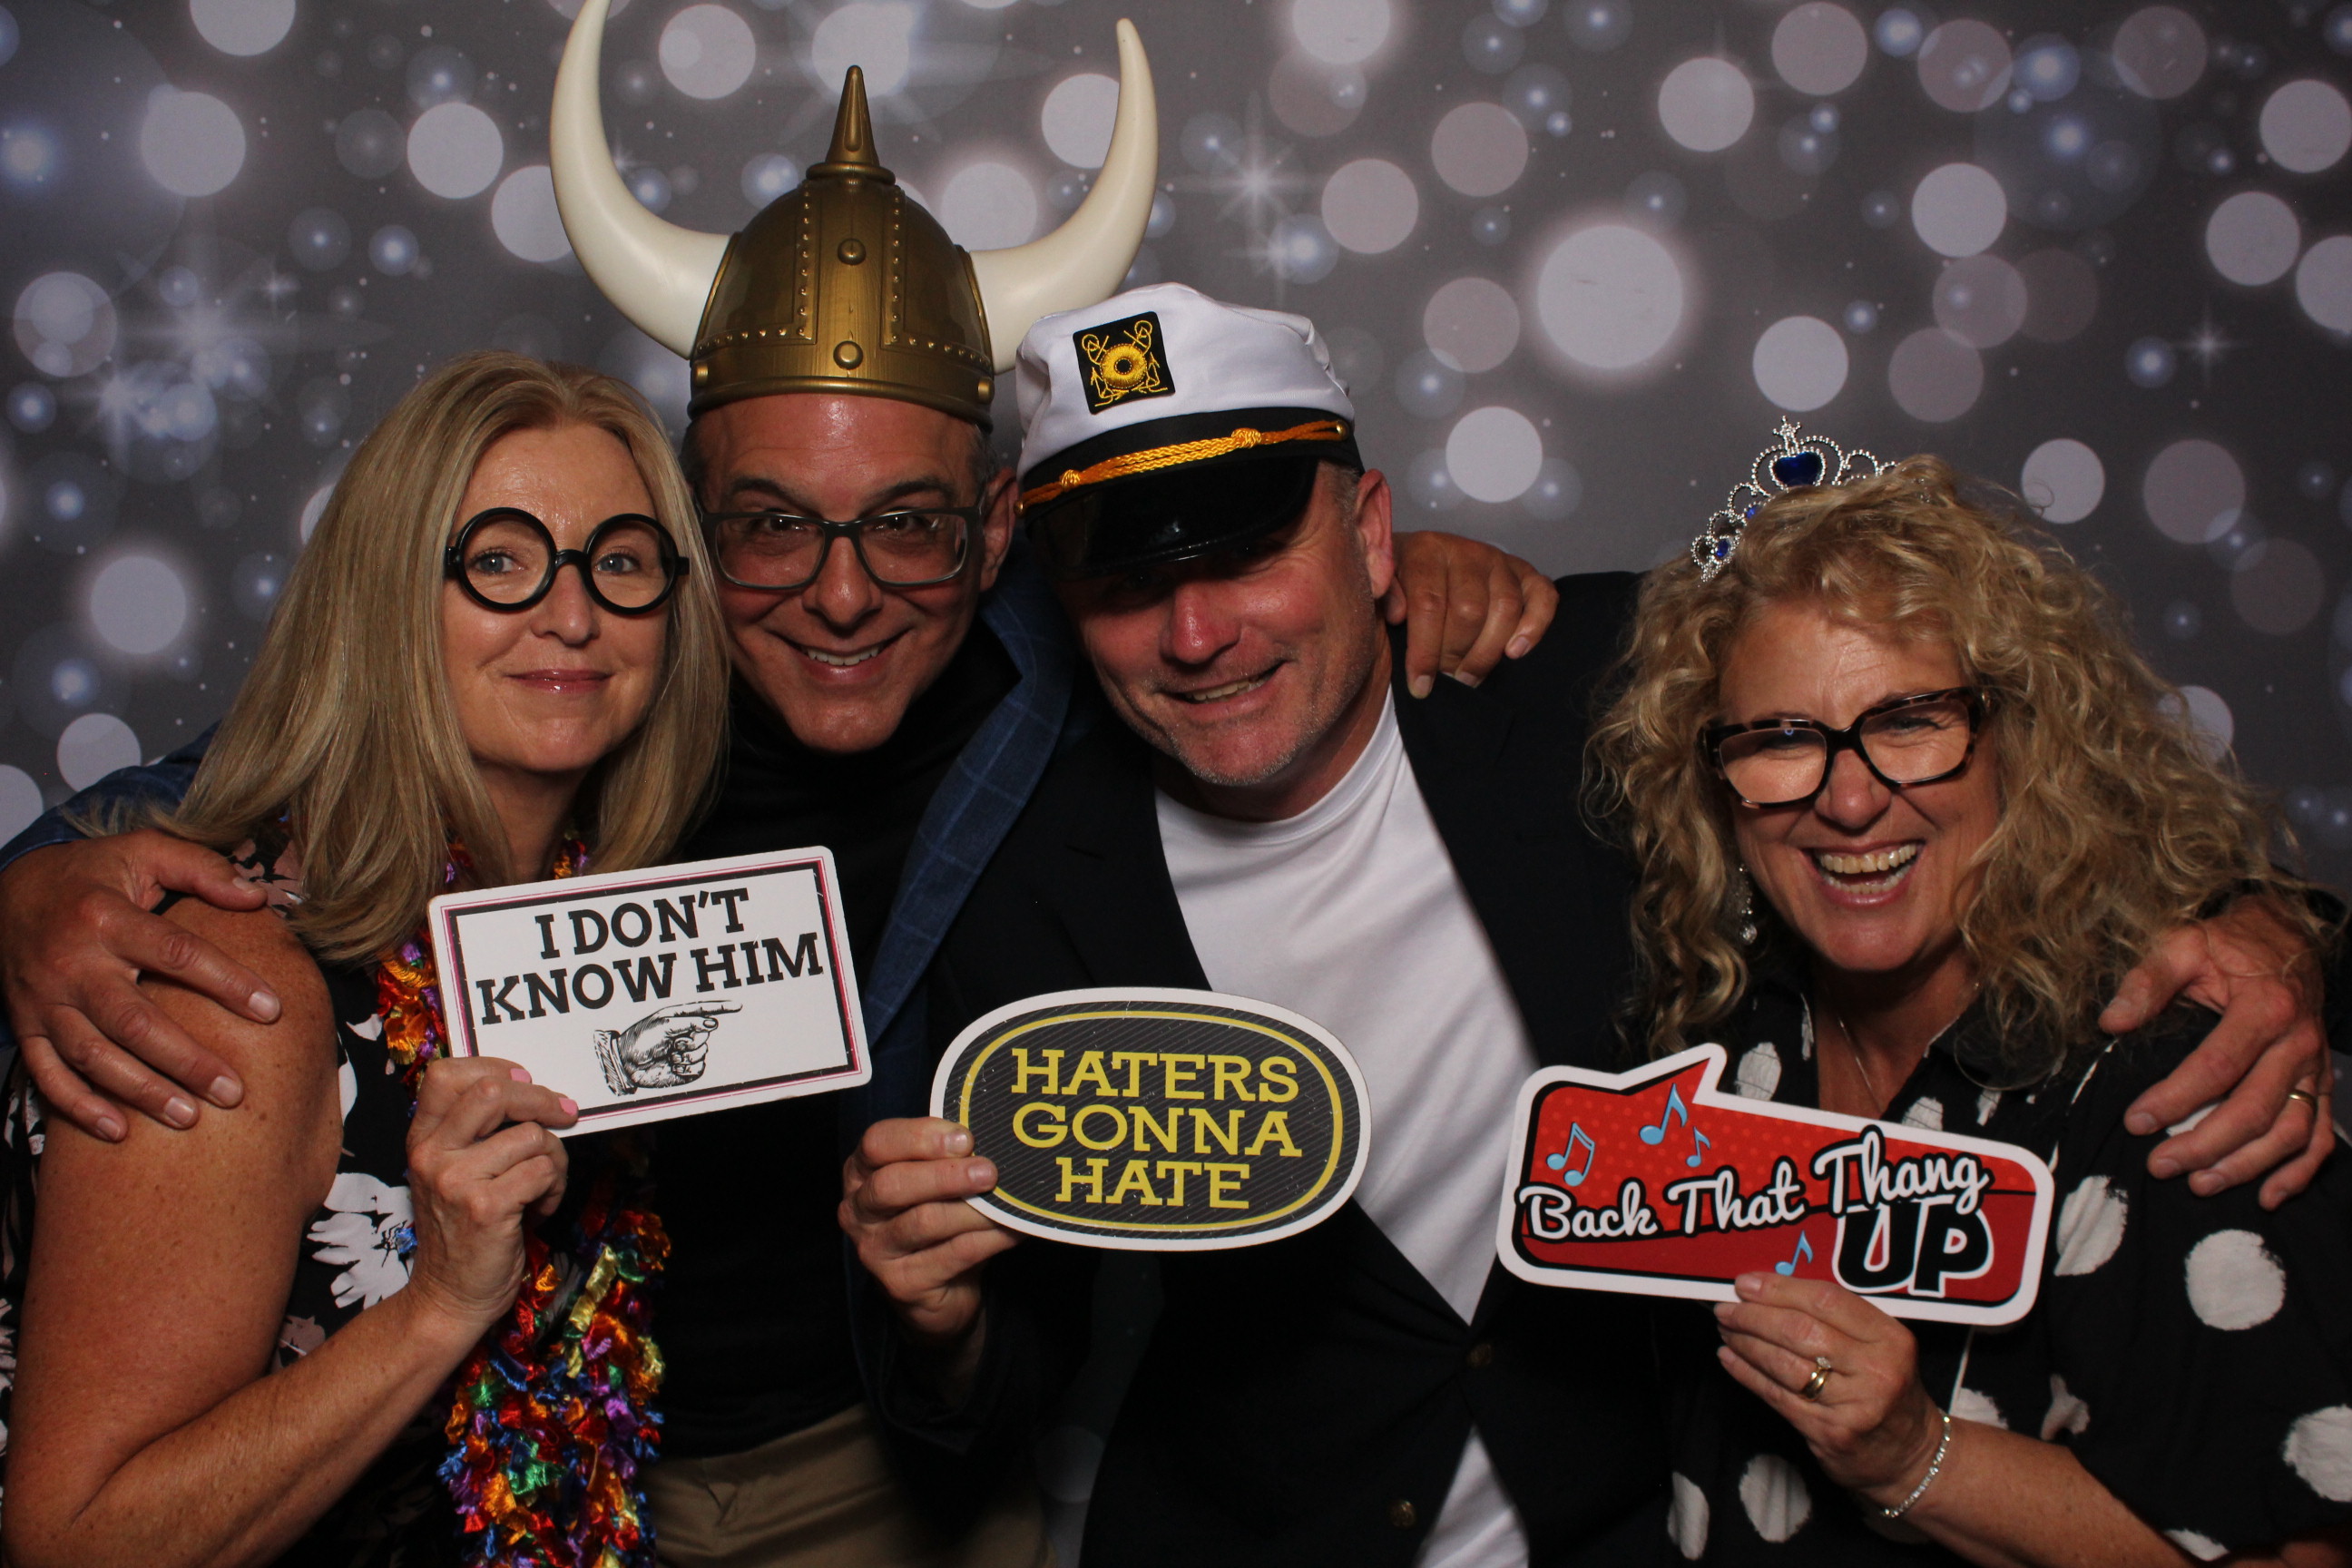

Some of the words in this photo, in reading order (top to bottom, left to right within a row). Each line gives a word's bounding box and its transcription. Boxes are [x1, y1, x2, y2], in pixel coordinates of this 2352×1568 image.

[535, 915, 560, 958] I
[568, 888, 749, 954] DON'T
[476, 953, 676, 1024] KNOW
[691, 933, 823, 992] HIM
[1012, 1048, 1298, 1102] HATERS
[1012, 1102, 1302, 1157] GONNA
[1055, 1157, 1250, 1209] HATE
[1519, 1182, 1659, 1238] Back
[1668, 1161, 1806, 1234] That
[1815, 1131, 1988, 1213] Thang
[1832, 1195, 1994, 1297] UP
